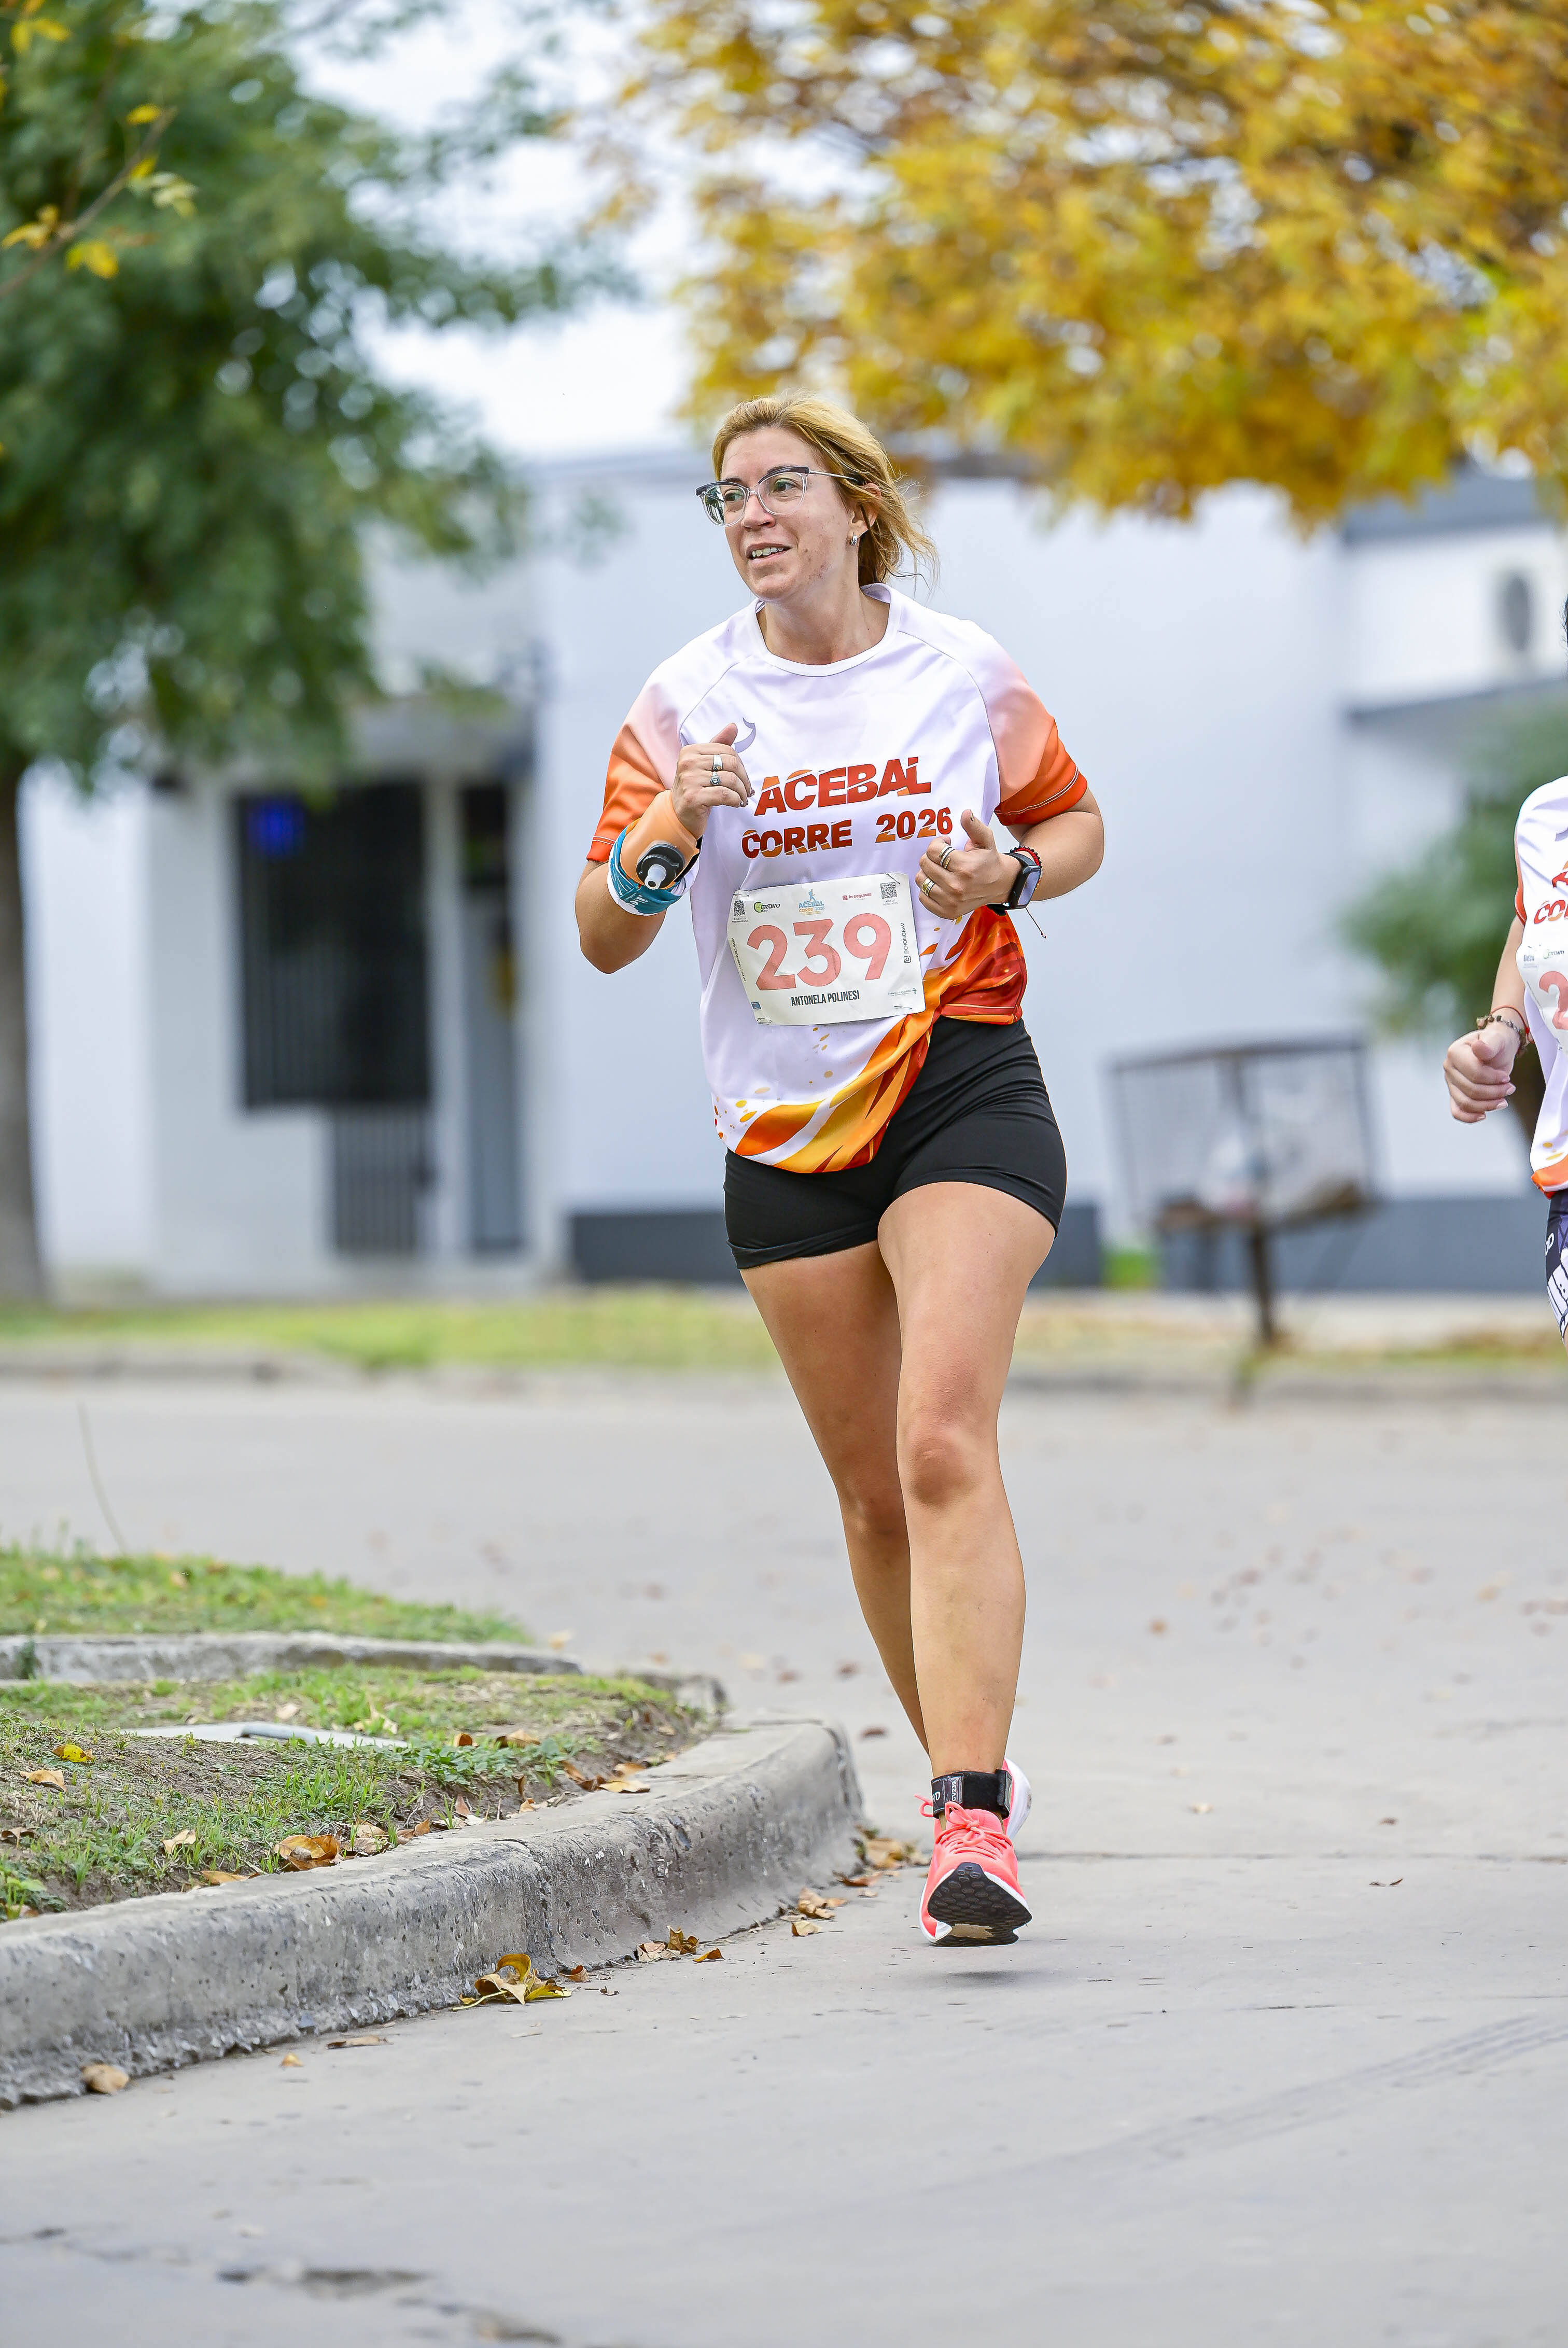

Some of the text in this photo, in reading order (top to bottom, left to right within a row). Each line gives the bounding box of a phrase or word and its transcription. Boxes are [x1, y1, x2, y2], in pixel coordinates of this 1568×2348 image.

[754, 757, 931, 816] ACEBAL
[741, 807, 953, 859] CORRE 2026
[799, 900, 824, 909] ACEBAL
[1534, 900, 1568, 924] CO
[747, 913, 892, 991] 239
[791, 989, 860, 1007] ANTONELA POLINESI
